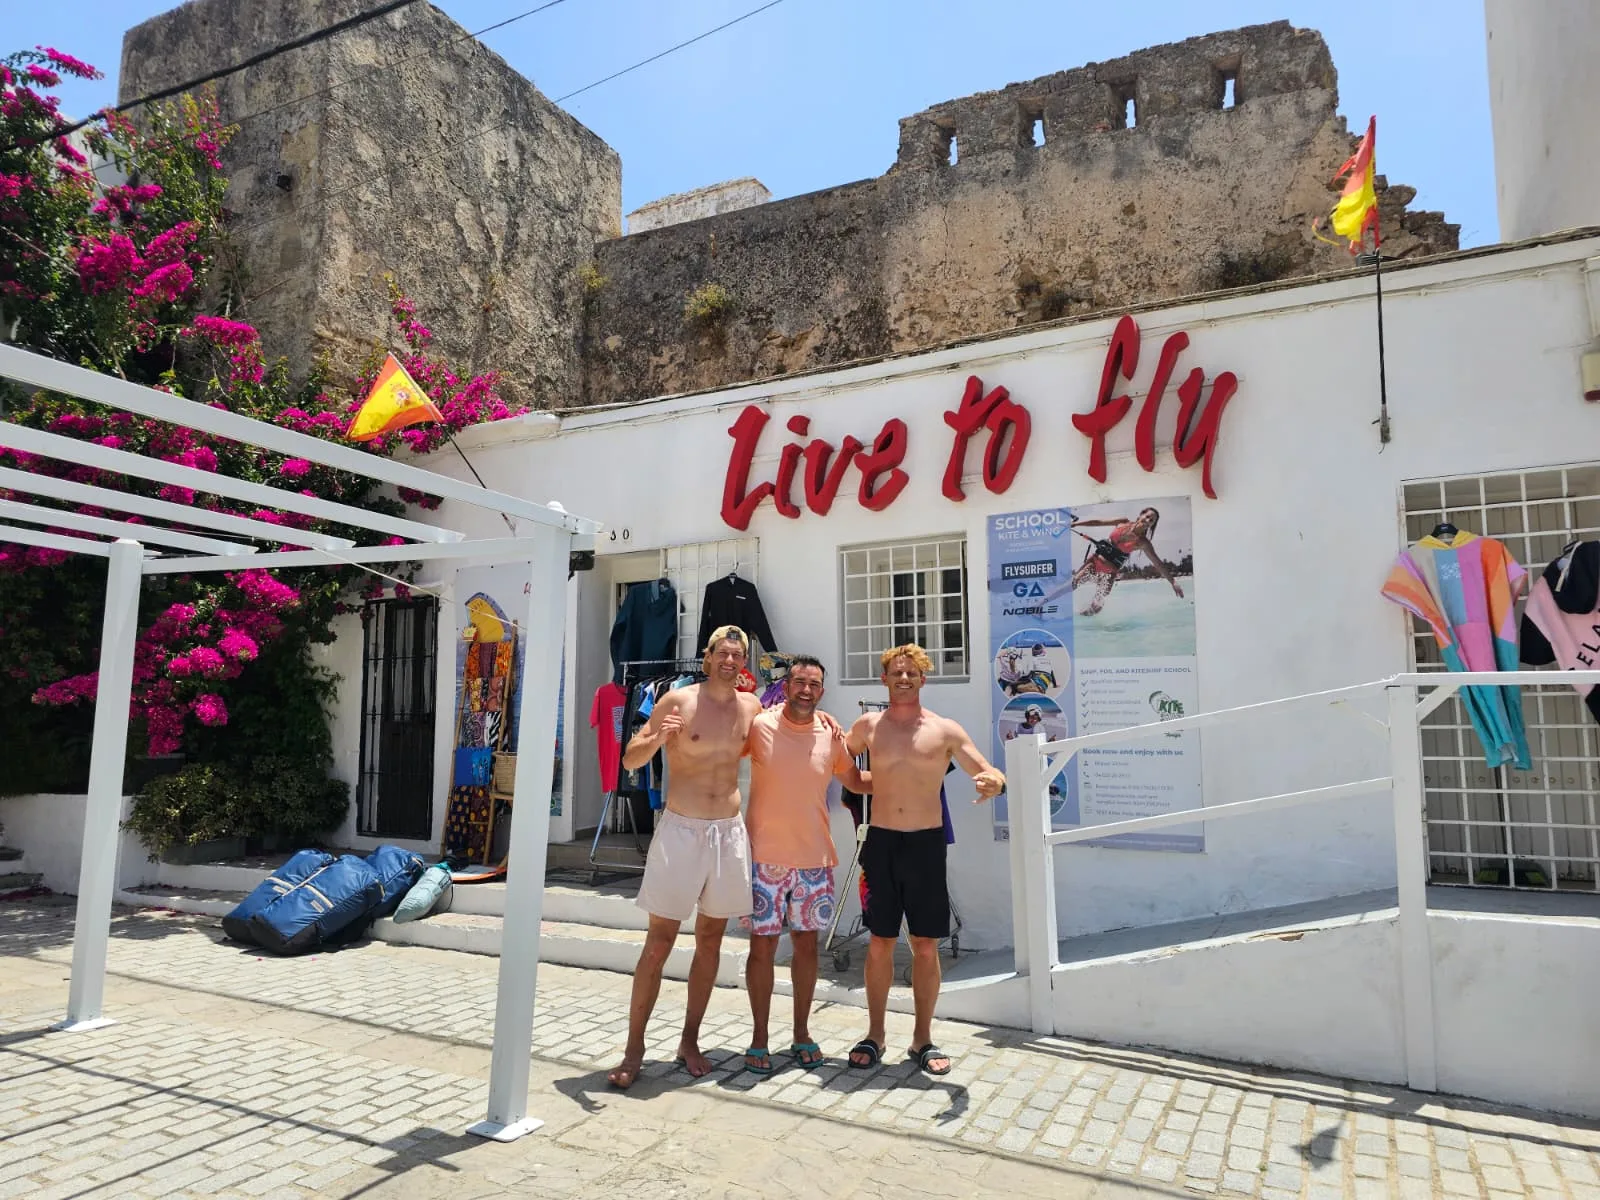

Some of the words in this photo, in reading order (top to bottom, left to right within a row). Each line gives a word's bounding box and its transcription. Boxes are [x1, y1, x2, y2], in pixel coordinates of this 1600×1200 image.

[719, 404, 910, 532] Live
[942, 374, 1032, 503] to
[1071, 313, 1239, 501] fly
[995, 512, 1066, 530] SCHOOL
[998, 530, 1020, 541] KITE
[1022, 530, 1029, 538] &
[1031, 526, 1060, 537] WING
[1004, 562, 1054, 577] FLYSURFER
[1013, 581, 1046, 598] GA
[1002, 605, 1059, 616] NOBILE
[1134, 748, 1154, 757] enjoy
[1156, 748, 1173, 756] with
